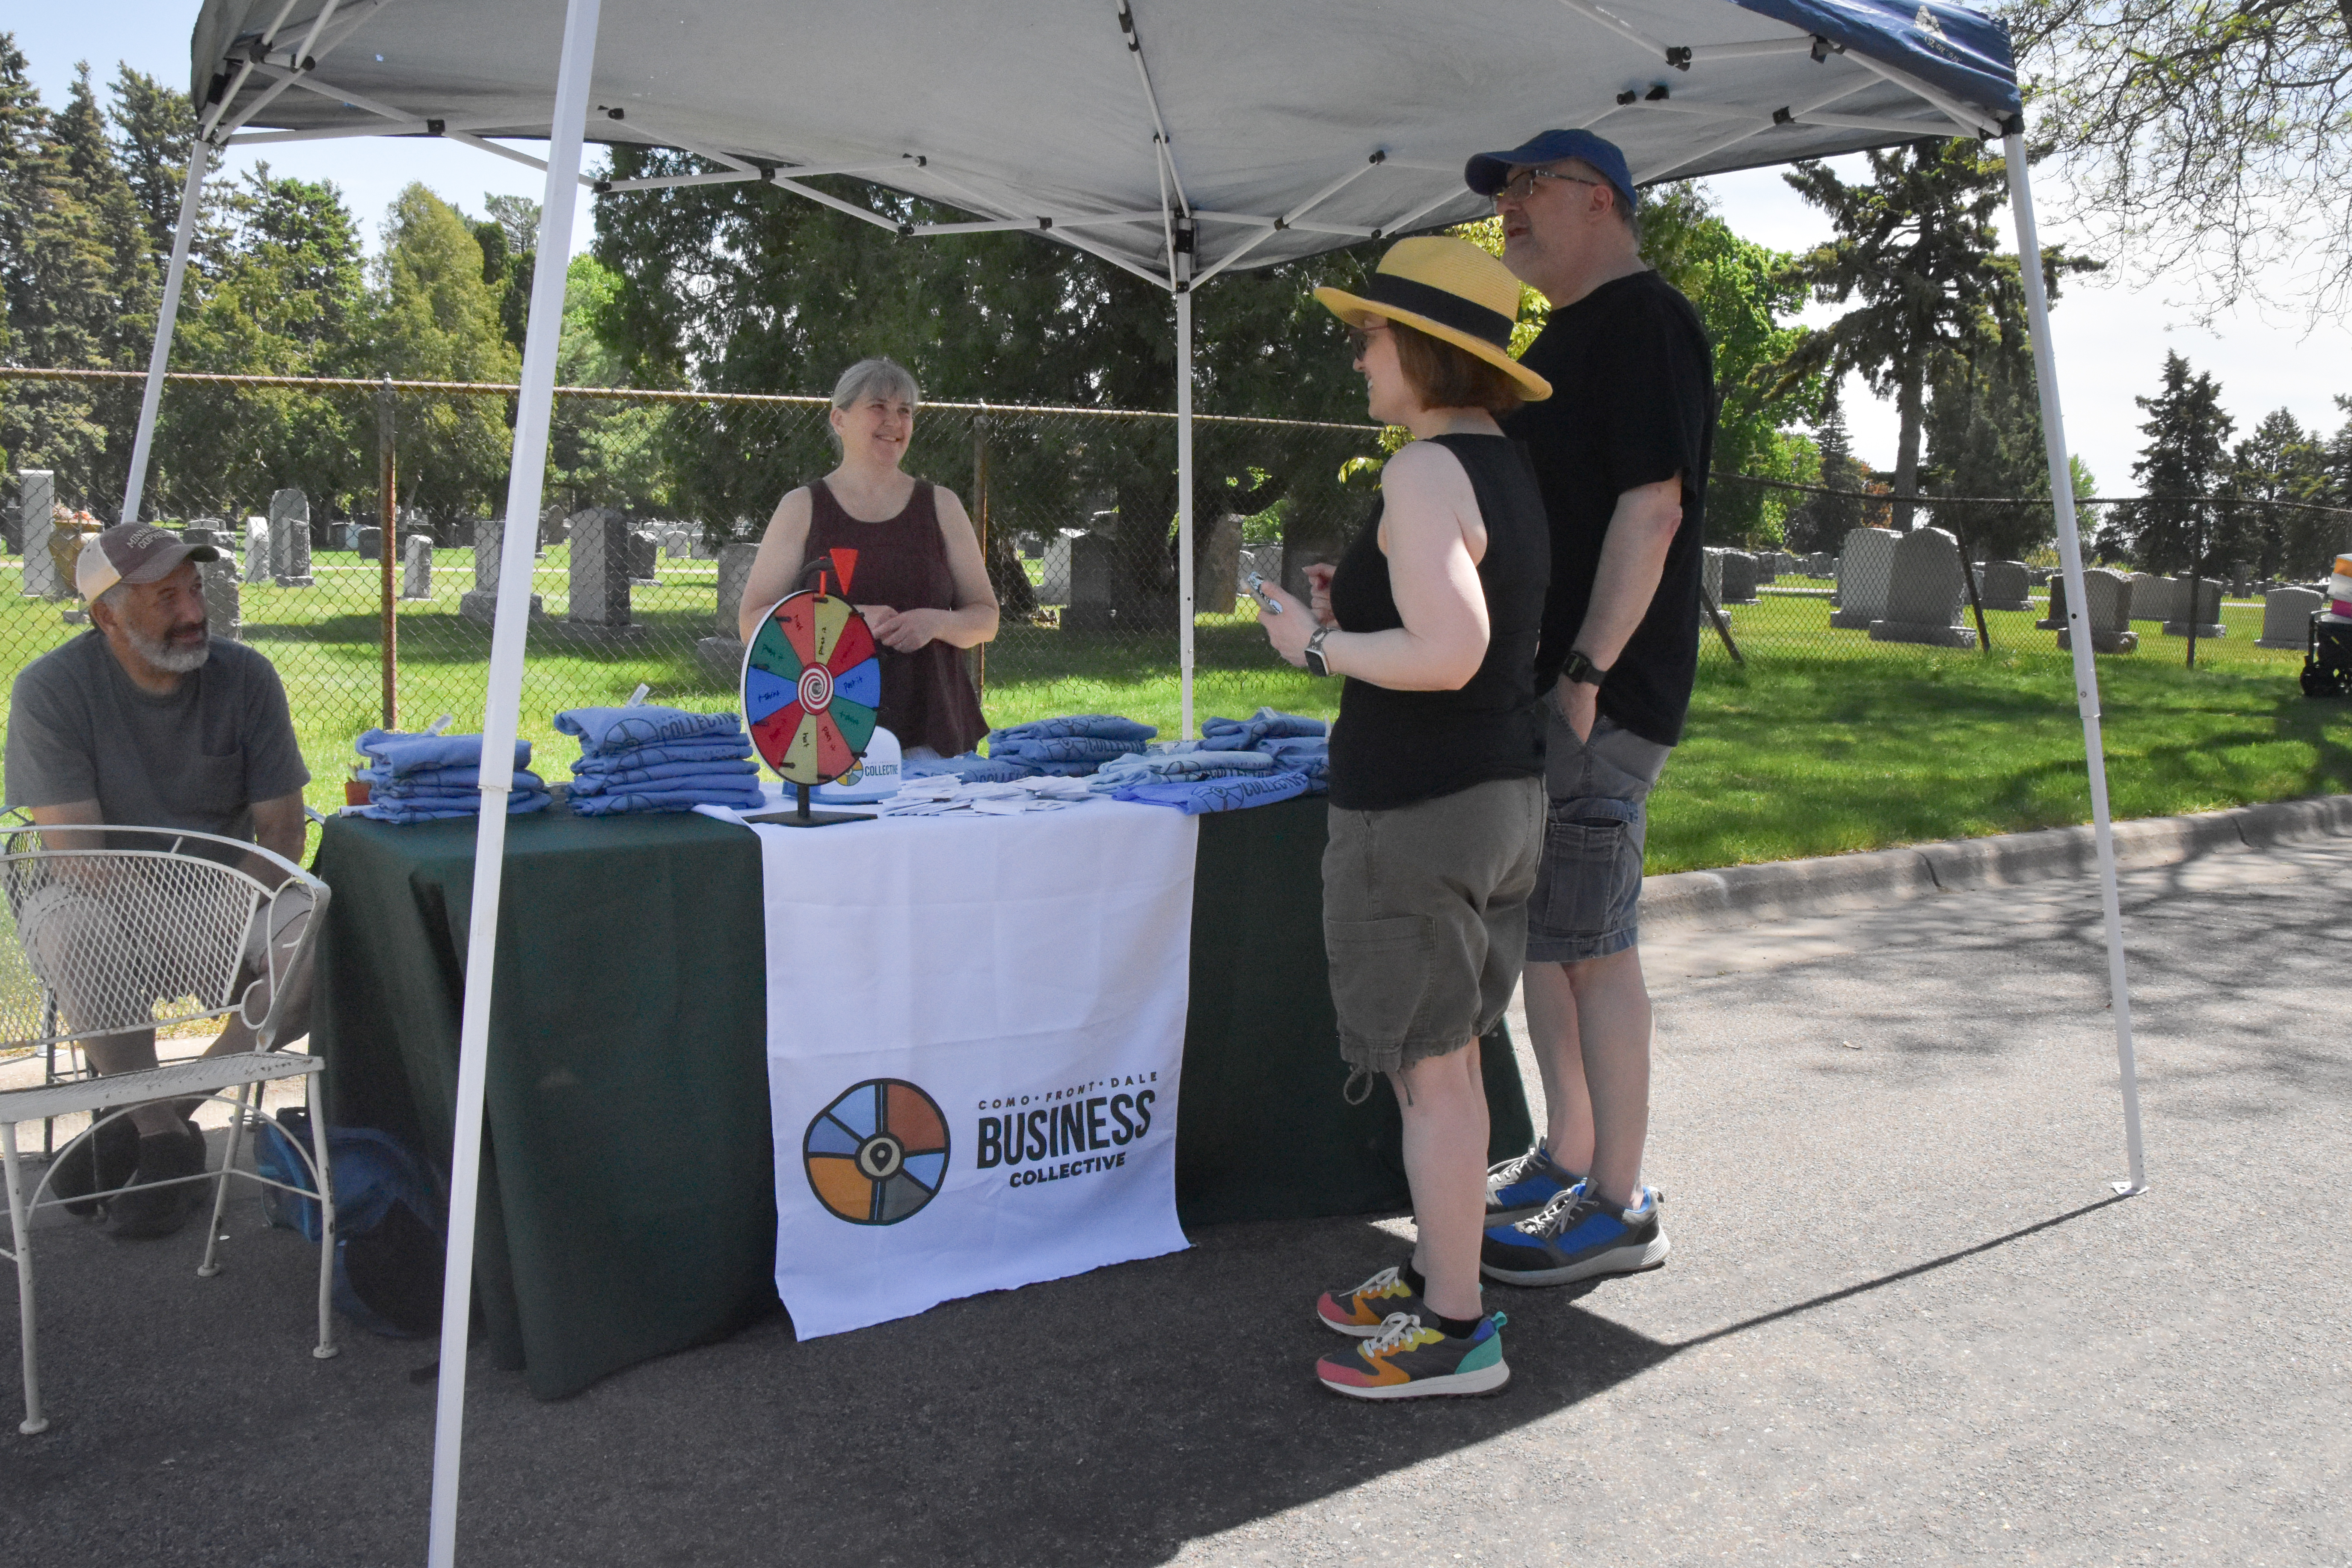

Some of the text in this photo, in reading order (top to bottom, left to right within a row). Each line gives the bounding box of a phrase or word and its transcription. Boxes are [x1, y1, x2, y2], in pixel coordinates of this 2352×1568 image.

[865, 764, 898, 777] COLLECTIVE
[979, 1071, 1157, 1110] COMO FRONT DALE
[976, 1089, 1156, 1169] BUSINESS
[1009, 1152, 1126, 1188] COLLECTIVE
